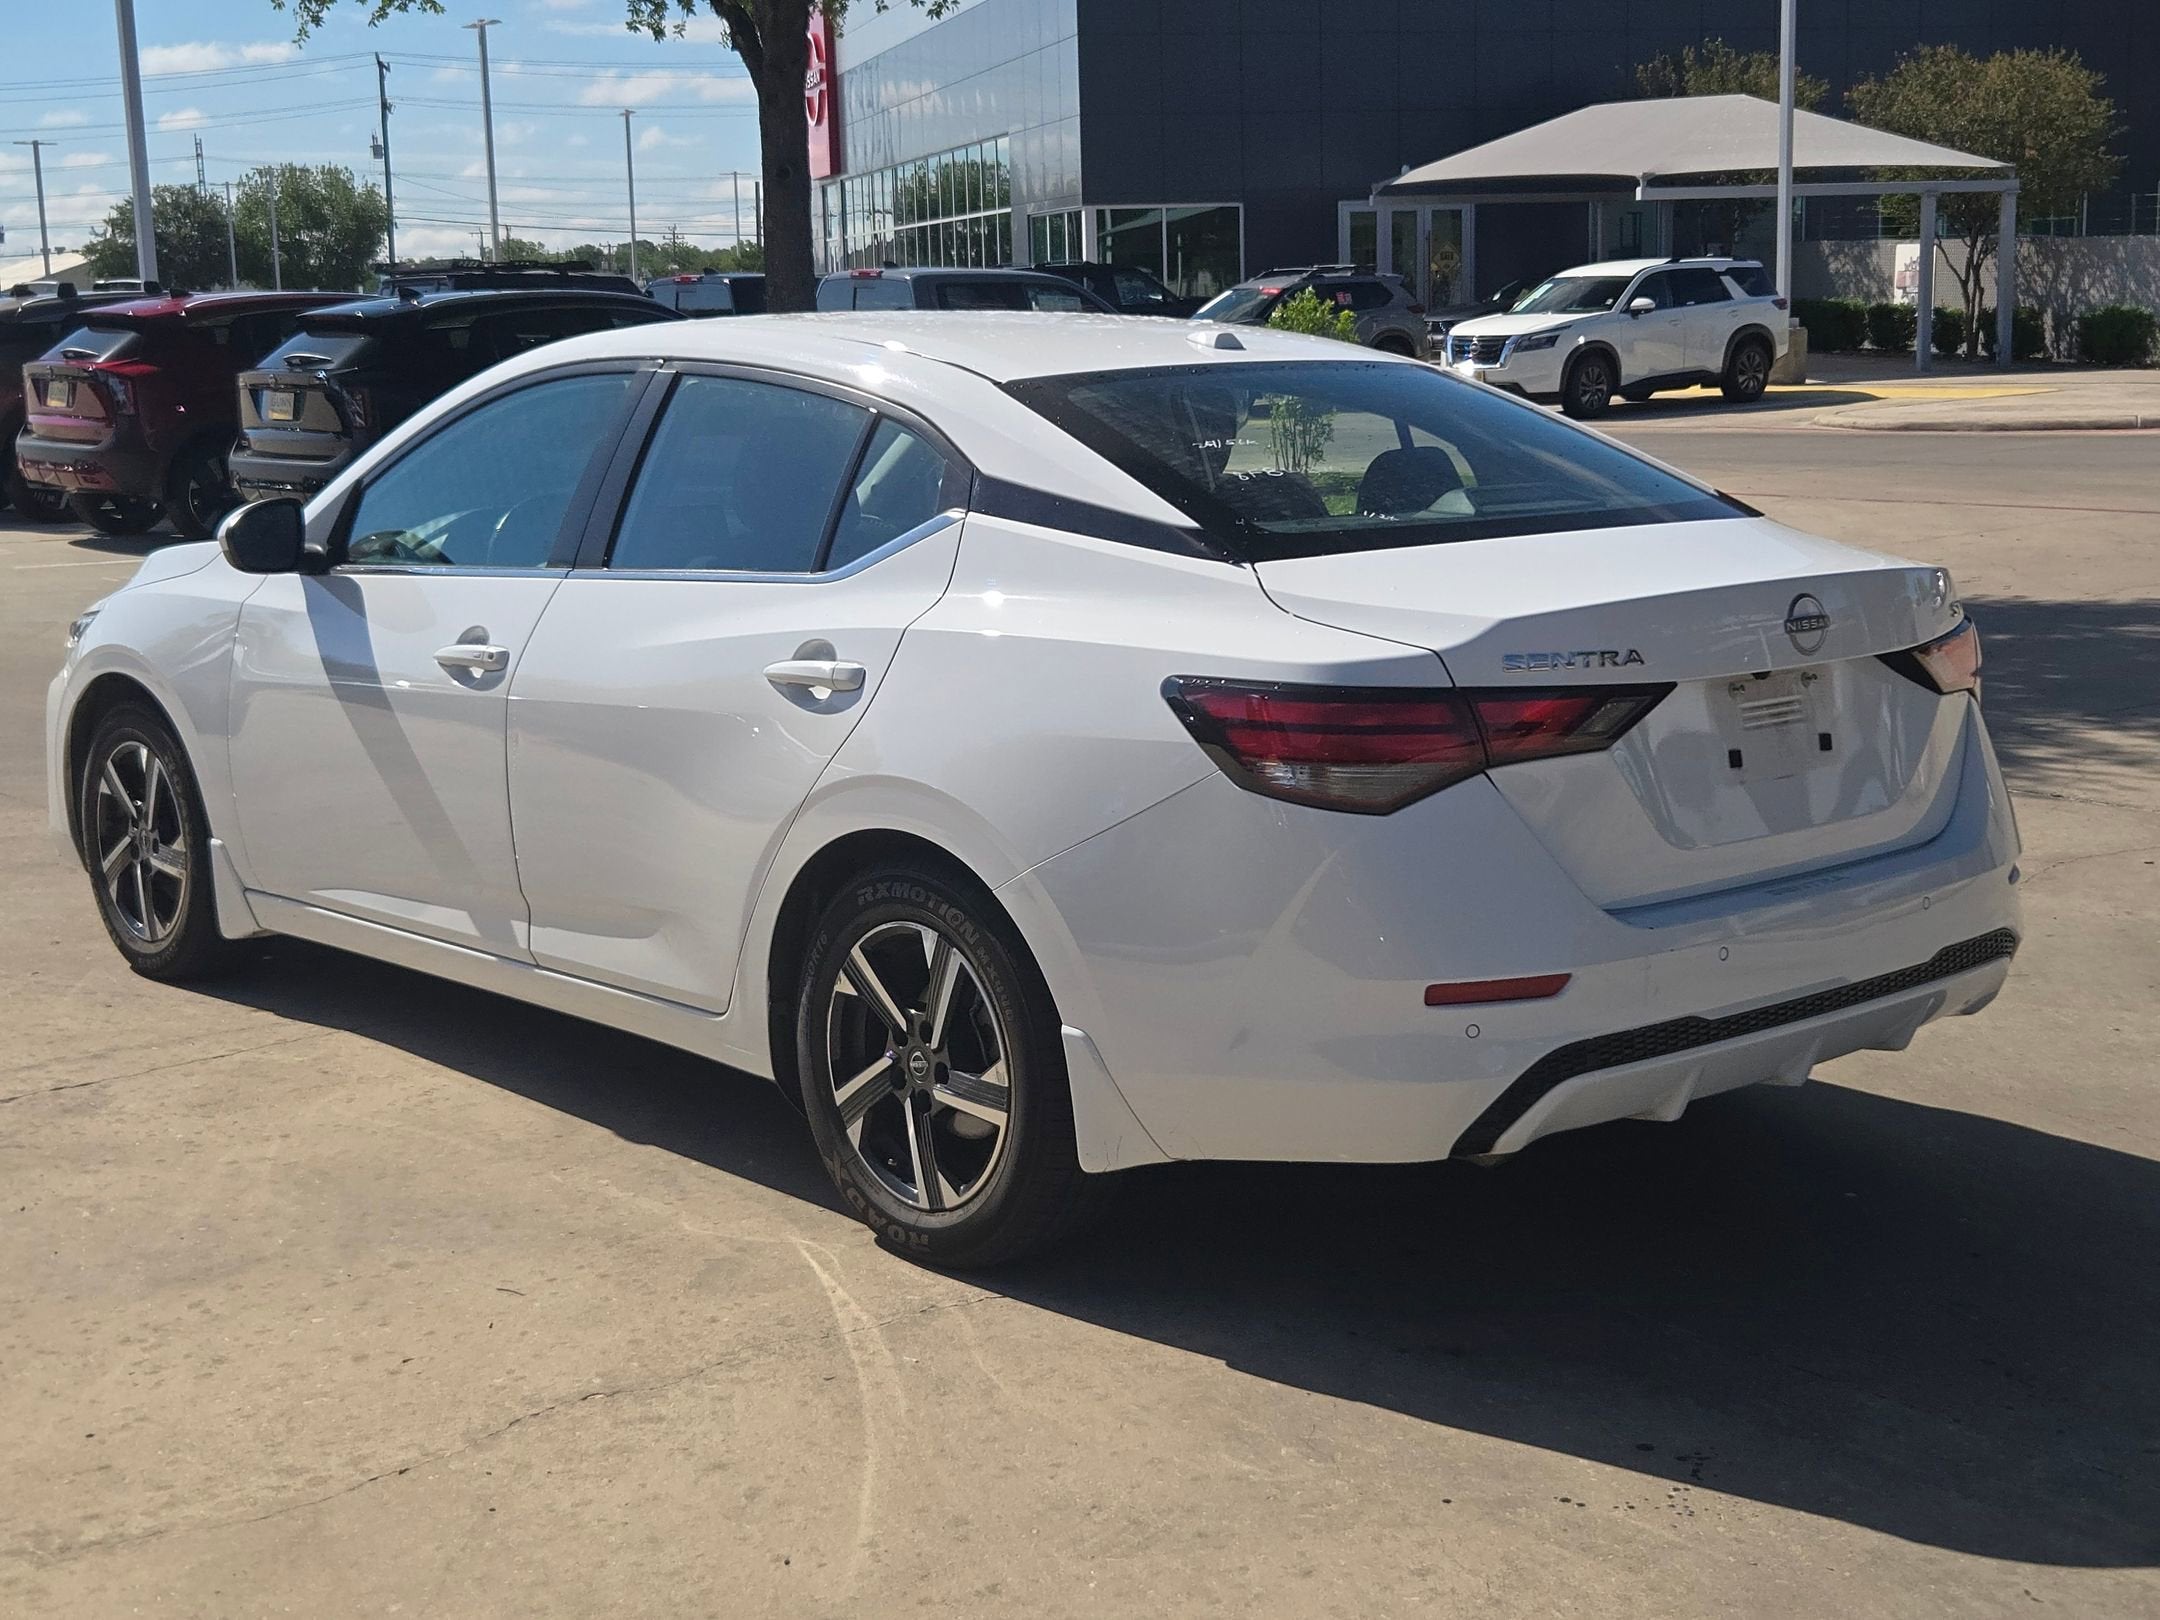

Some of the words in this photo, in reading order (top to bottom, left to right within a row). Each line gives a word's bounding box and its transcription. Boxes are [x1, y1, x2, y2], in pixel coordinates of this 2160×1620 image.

[1786, 617, 1831, 632] NISSAN
[1502, 648, 1645, 673] SENTRA
[823, 1151, 929, 1246] ROADX
